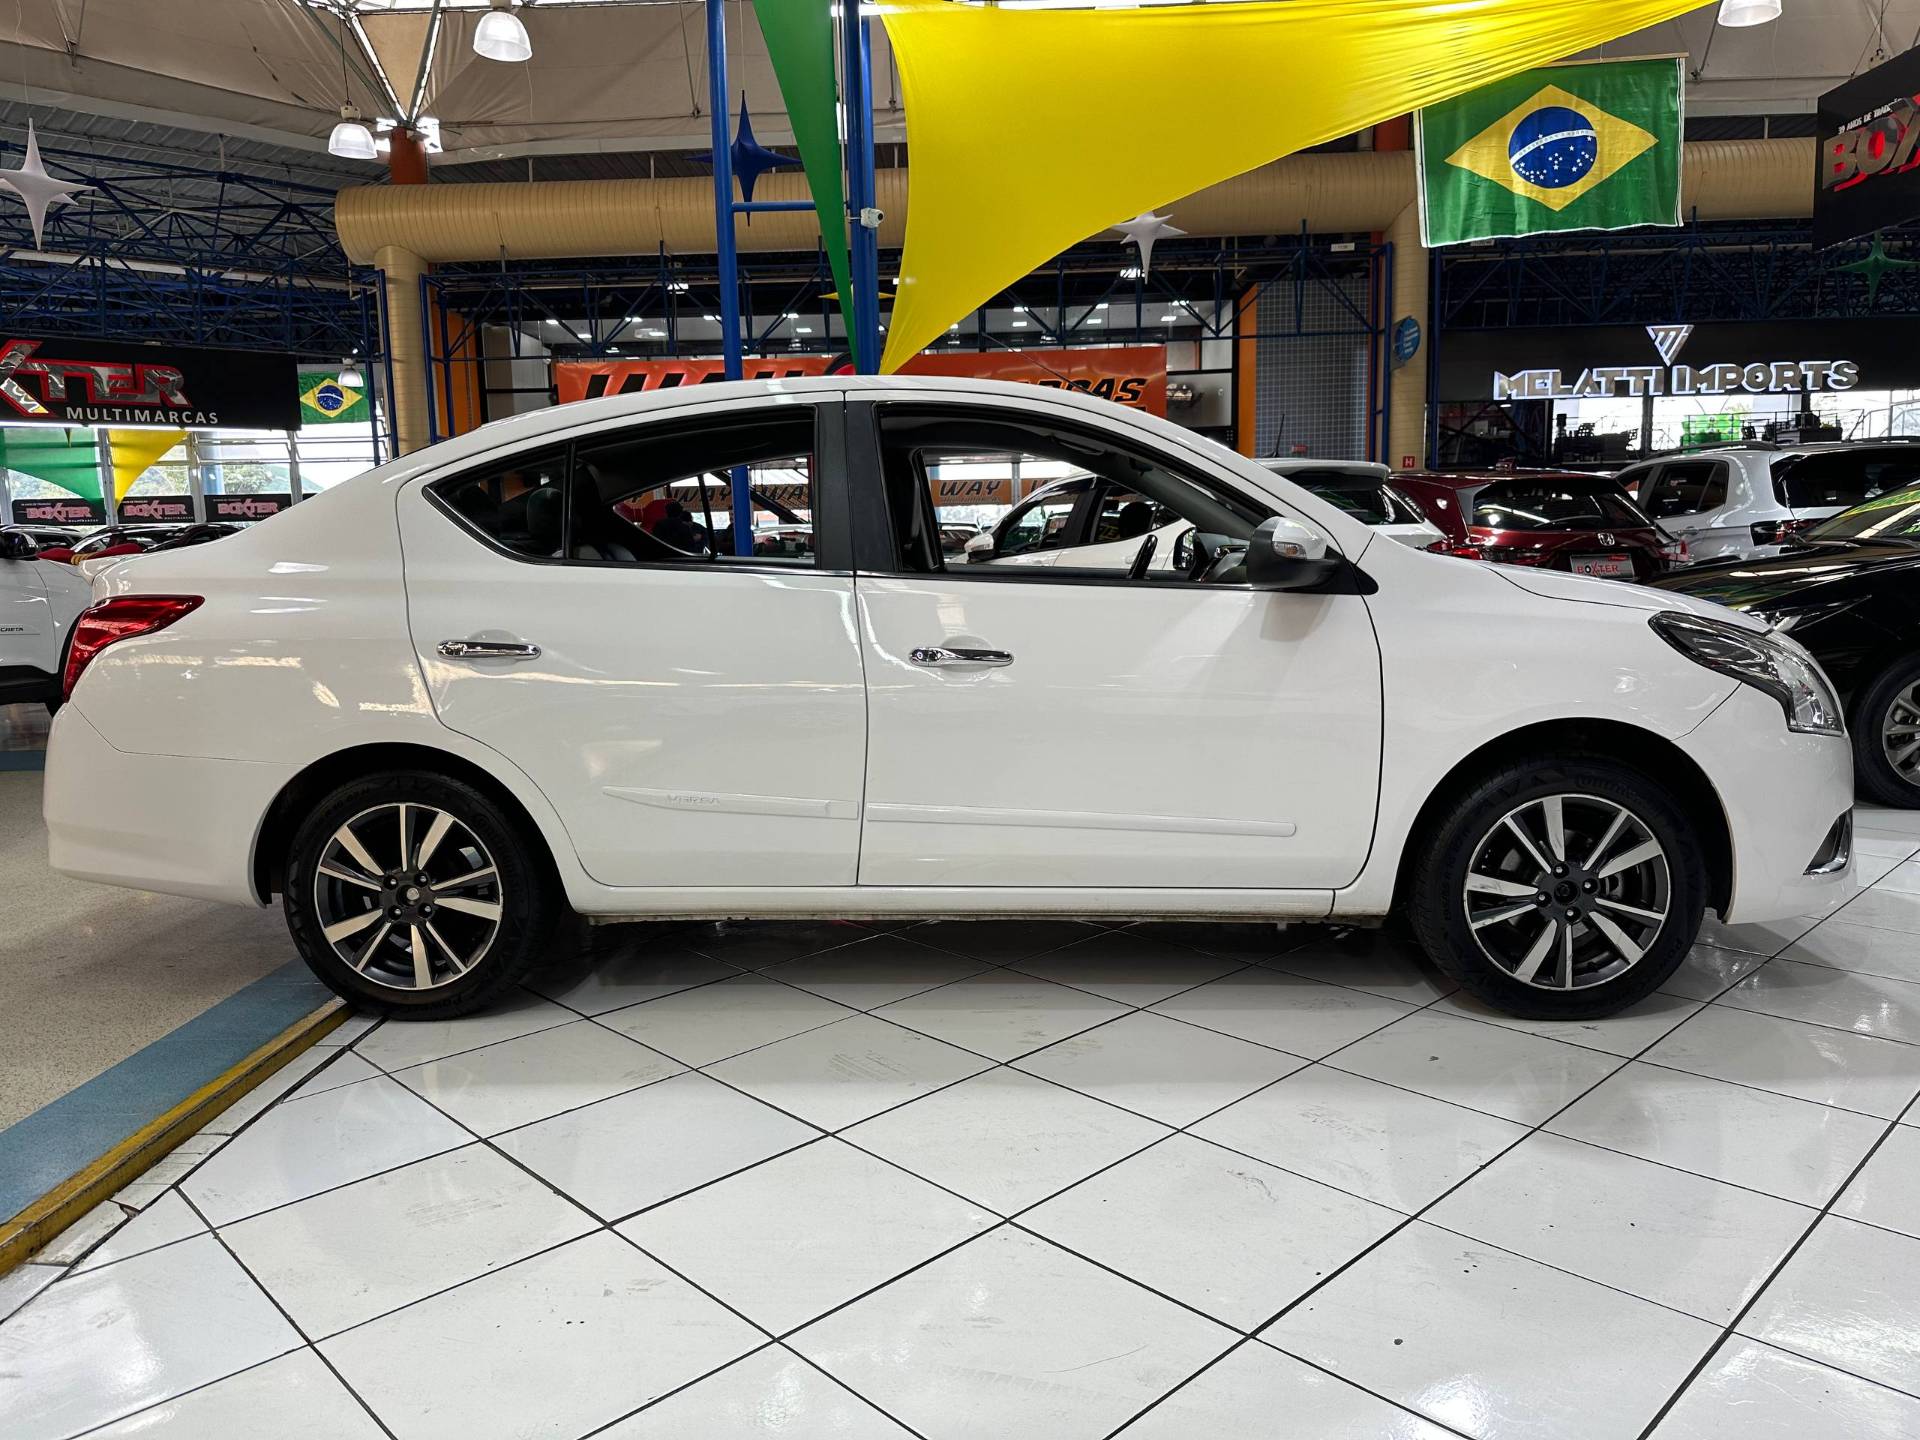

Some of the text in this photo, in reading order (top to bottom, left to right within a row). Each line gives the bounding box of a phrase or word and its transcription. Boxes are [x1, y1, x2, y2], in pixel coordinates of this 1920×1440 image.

[1846, 117, 1862, 131] ANOS
[1863, 111, 1873, 123] DE
[1494, 360, 1860, 400] MELATTI IMPORTS
[66, 406, 218, 424] MULTIMARCAS
[940, 480, 1000, 496] WAY
[26, 502, 92, 522] BOXTER
[123, 500, 187, 520] BOXTER
[217, 498, 279, 518] BOXTER
[1576, 561, 1618, 577] BOXTER
